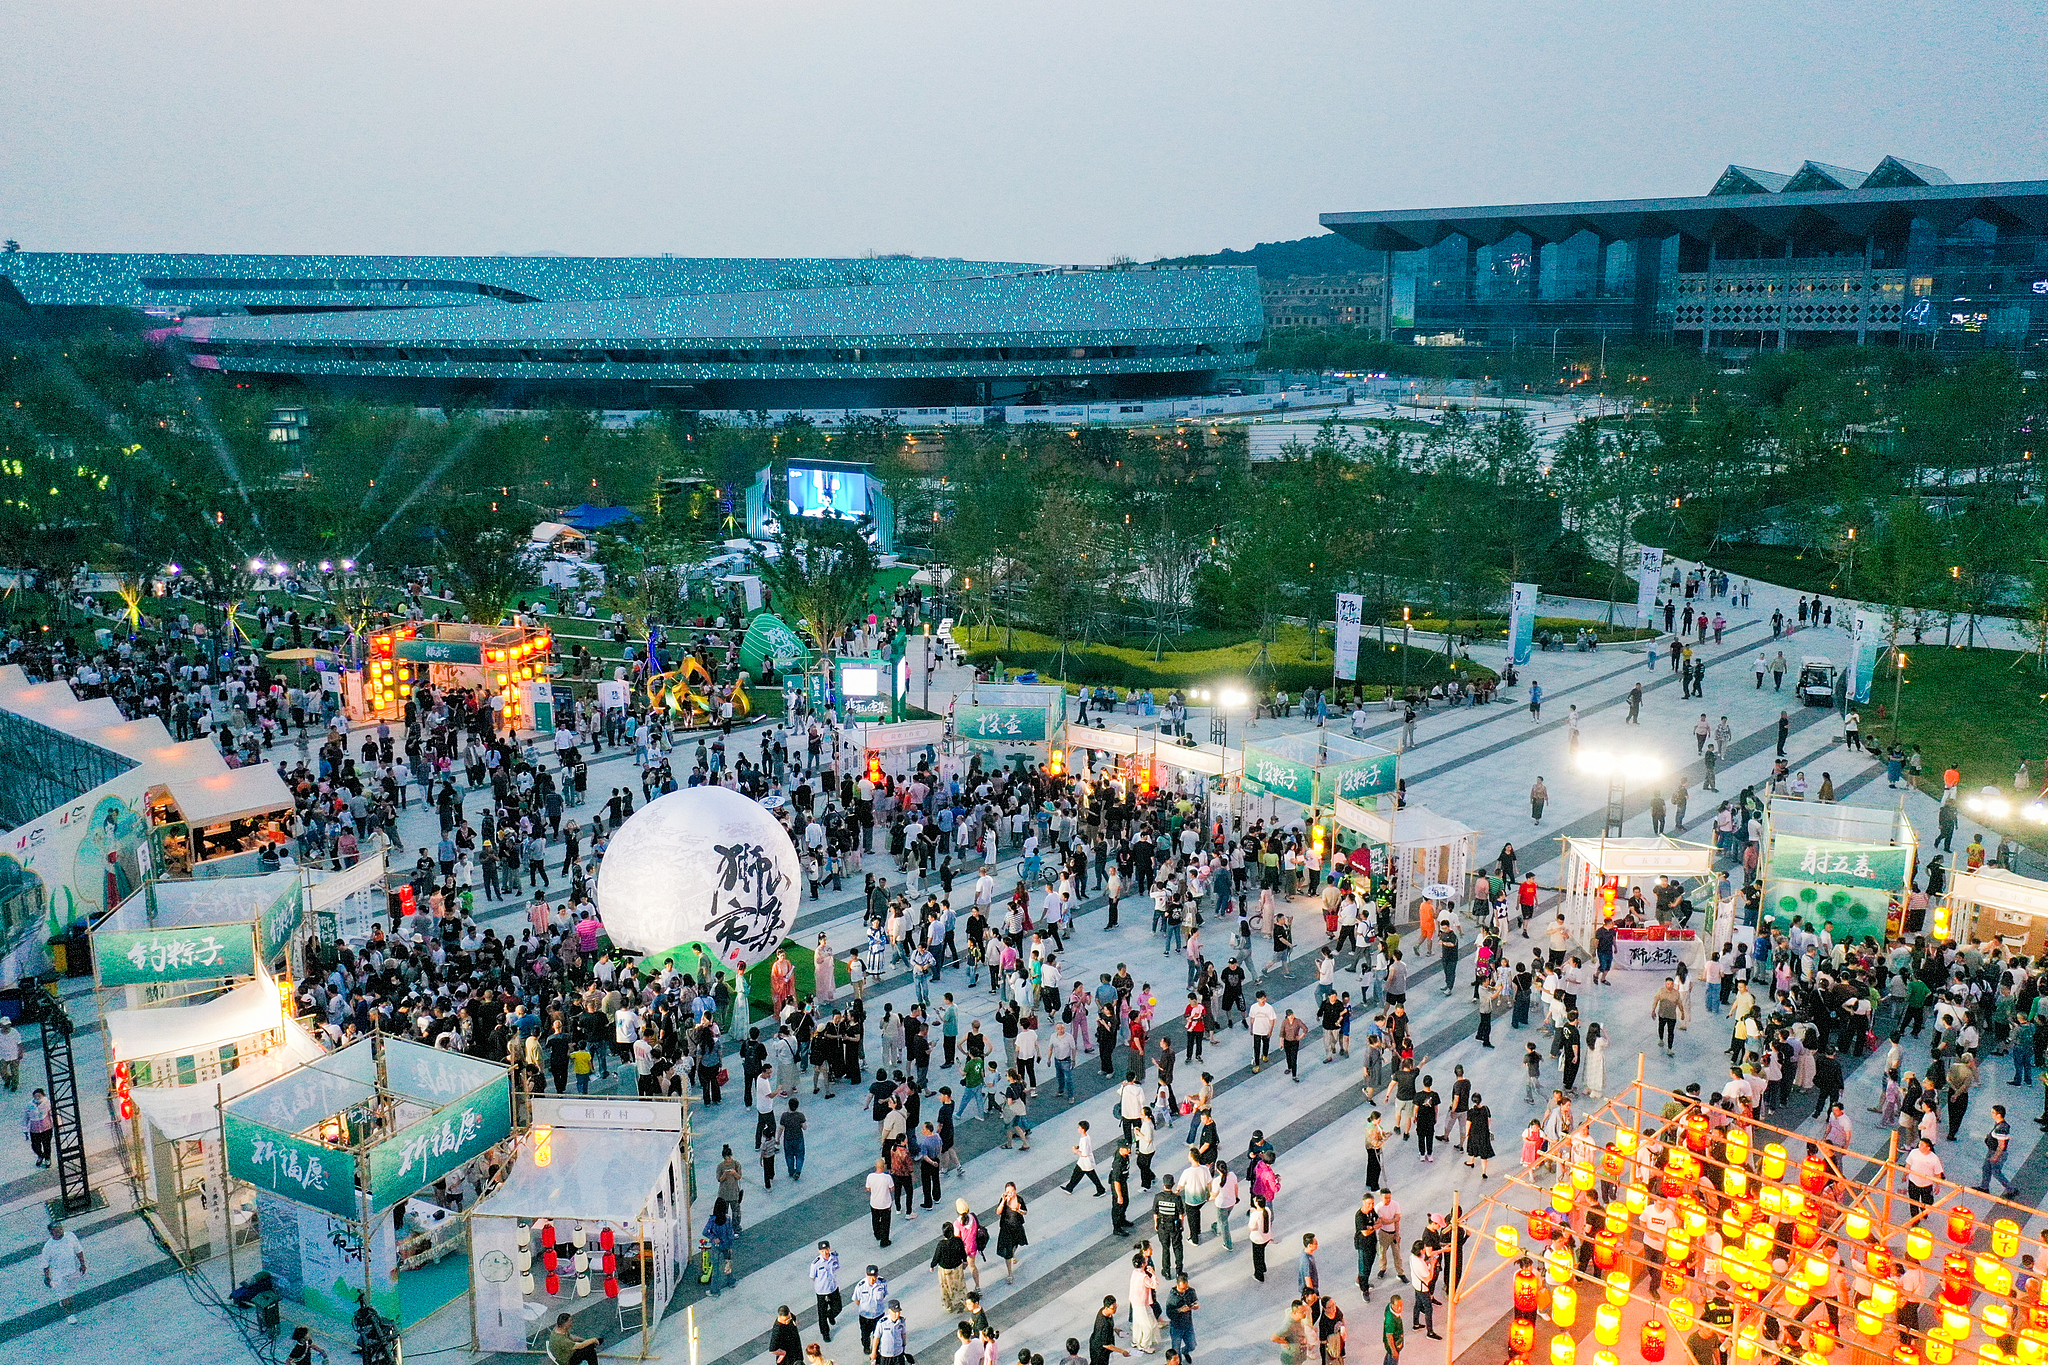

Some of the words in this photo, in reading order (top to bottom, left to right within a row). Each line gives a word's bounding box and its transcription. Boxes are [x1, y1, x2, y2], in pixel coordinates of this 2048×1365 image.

[1800, 845, 1872, 877] 射五毒
[128, 937, 224, 972] 钓粽子
[585, 1108, 629, 1120] 稻香村
[399, 1107, 482, 1183] 祈福愿
[251, 1137, 328, 1191] 祈福愿
